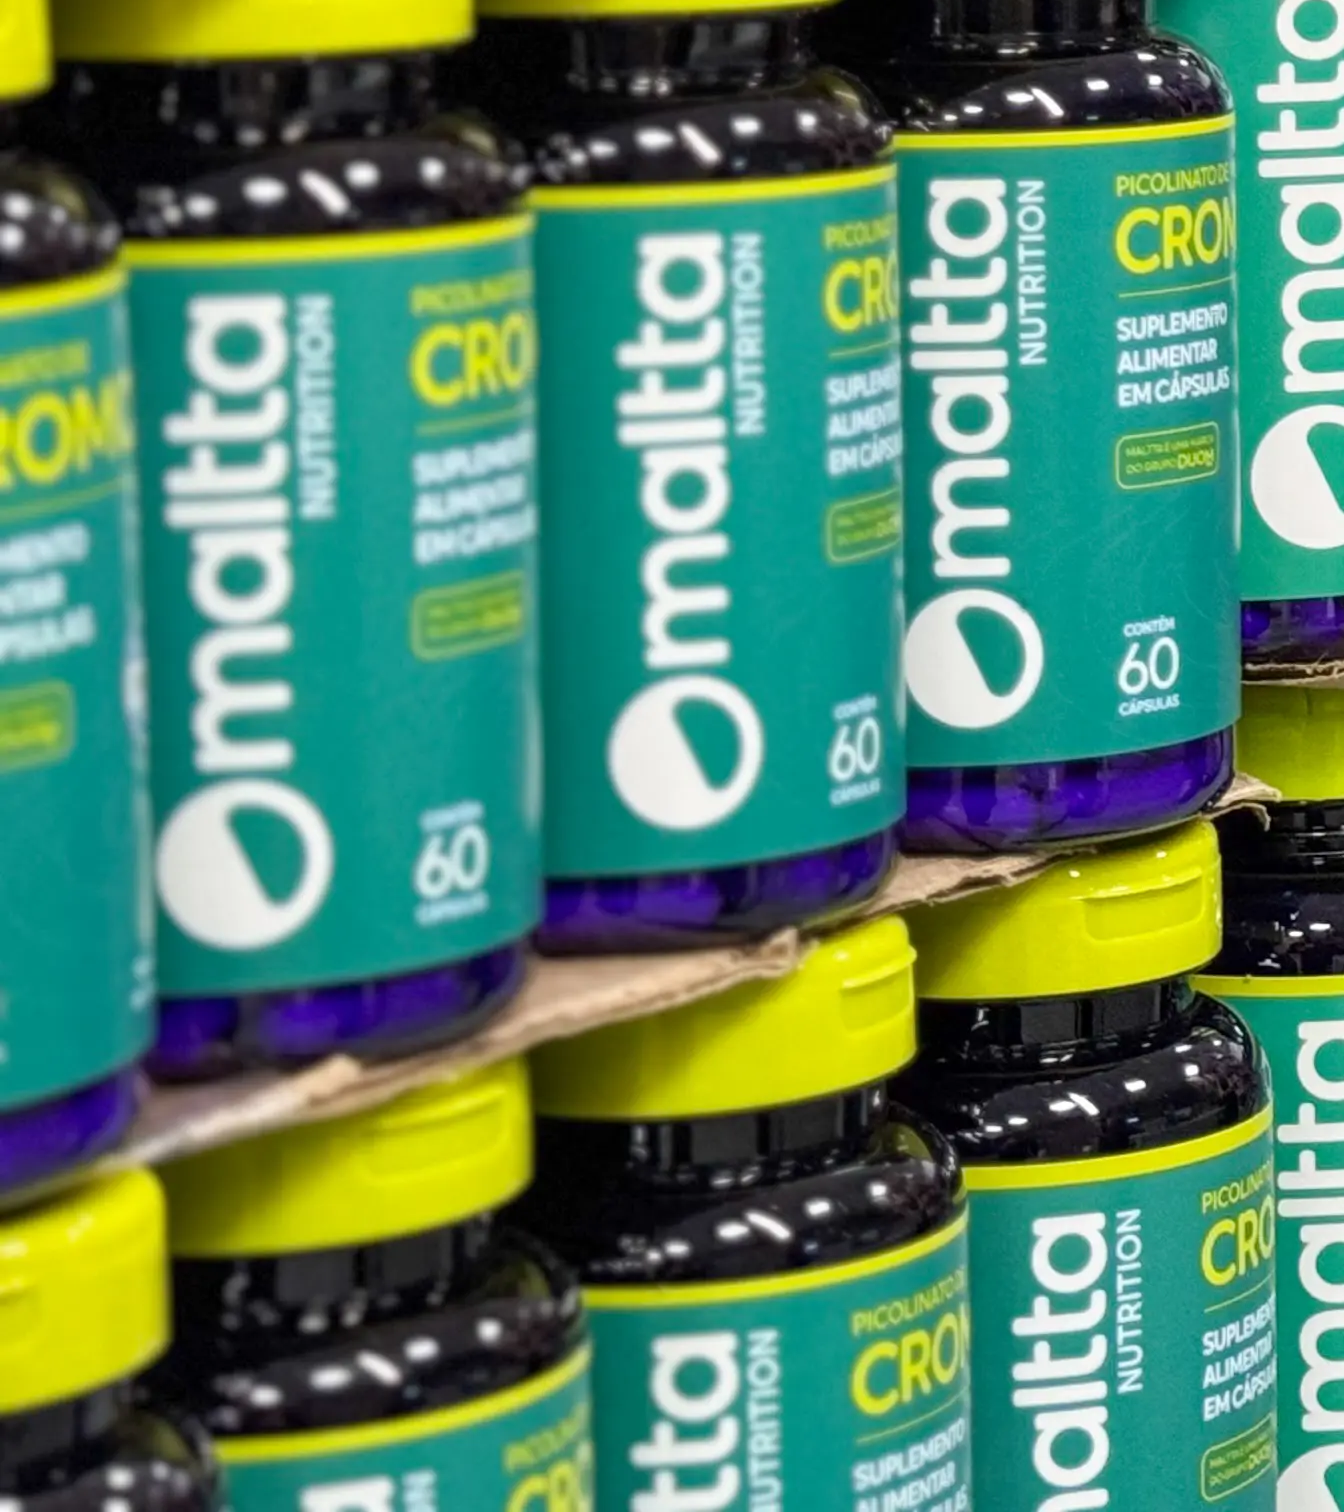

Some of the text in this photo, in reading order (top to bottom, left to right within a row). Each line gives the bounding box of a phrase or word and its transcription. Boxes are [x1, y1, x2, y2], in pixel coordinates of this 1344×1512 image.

[1116, 165, 1217, 197] PICOLINATO
[1018, 179, 1048, 365] NUTRITION
[733, 233, 766, 437] NUTRITION
[1117, 302, 1227, 341] SUPLEMENTO
[1117, 338, 1218, 374] ALIMENTAR
[296, 296, 337, 519] NUTRITION
[909, 178, 1010, 578] maltta
[1118, 366, 1230, 407] EM CÁPSULAS
[616, 231, 731, 668] maltta
[162, 294, 294, 773] maltta
[1118, 637, 1179, 695] 60
[1118, 694, 1180, 717] CÁPSULAS
[828, 716, 880, 782] 60
[415, 823, 490, 899] 60
[1117, 1208, 1143, 1394] NUTRITION
[748, 1330, 781, 1512] UTRITION
[1204, 1390, 1230, 1422] EM
